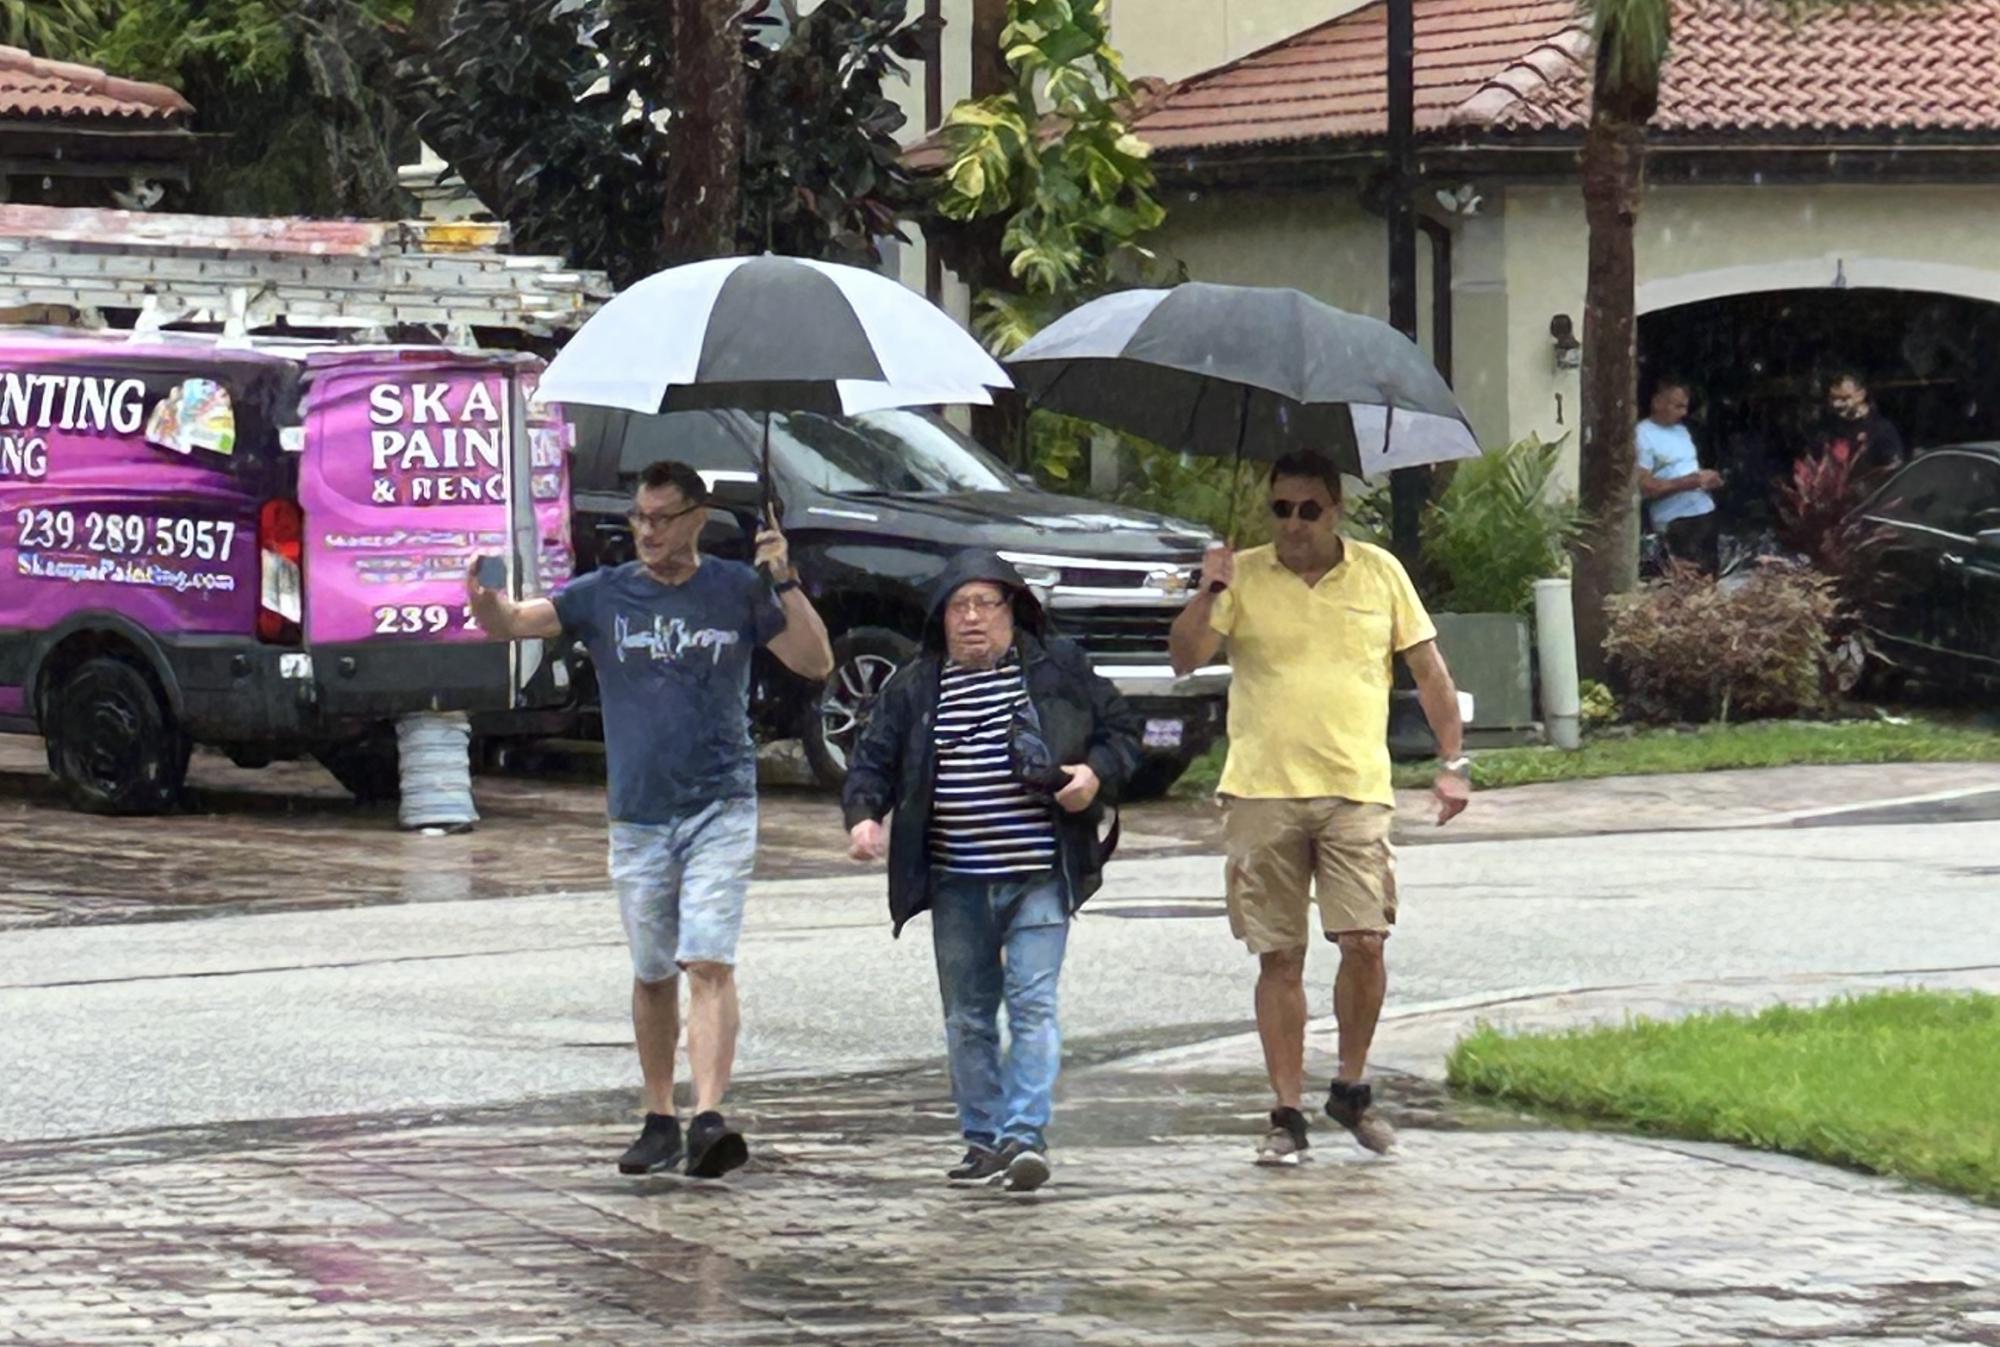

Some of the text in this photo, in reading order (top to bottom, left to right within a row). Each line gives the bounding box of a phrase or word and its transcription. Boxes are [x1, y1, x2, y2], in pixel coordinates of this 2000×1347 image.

[0, 372, 145, 433] NTING
[372, 428, 500, 470] PAIN
[371, 478, 395, 503] &
[17, 508, 235, 562] 239 289 5957
[375, 605, 449, 634] 239
